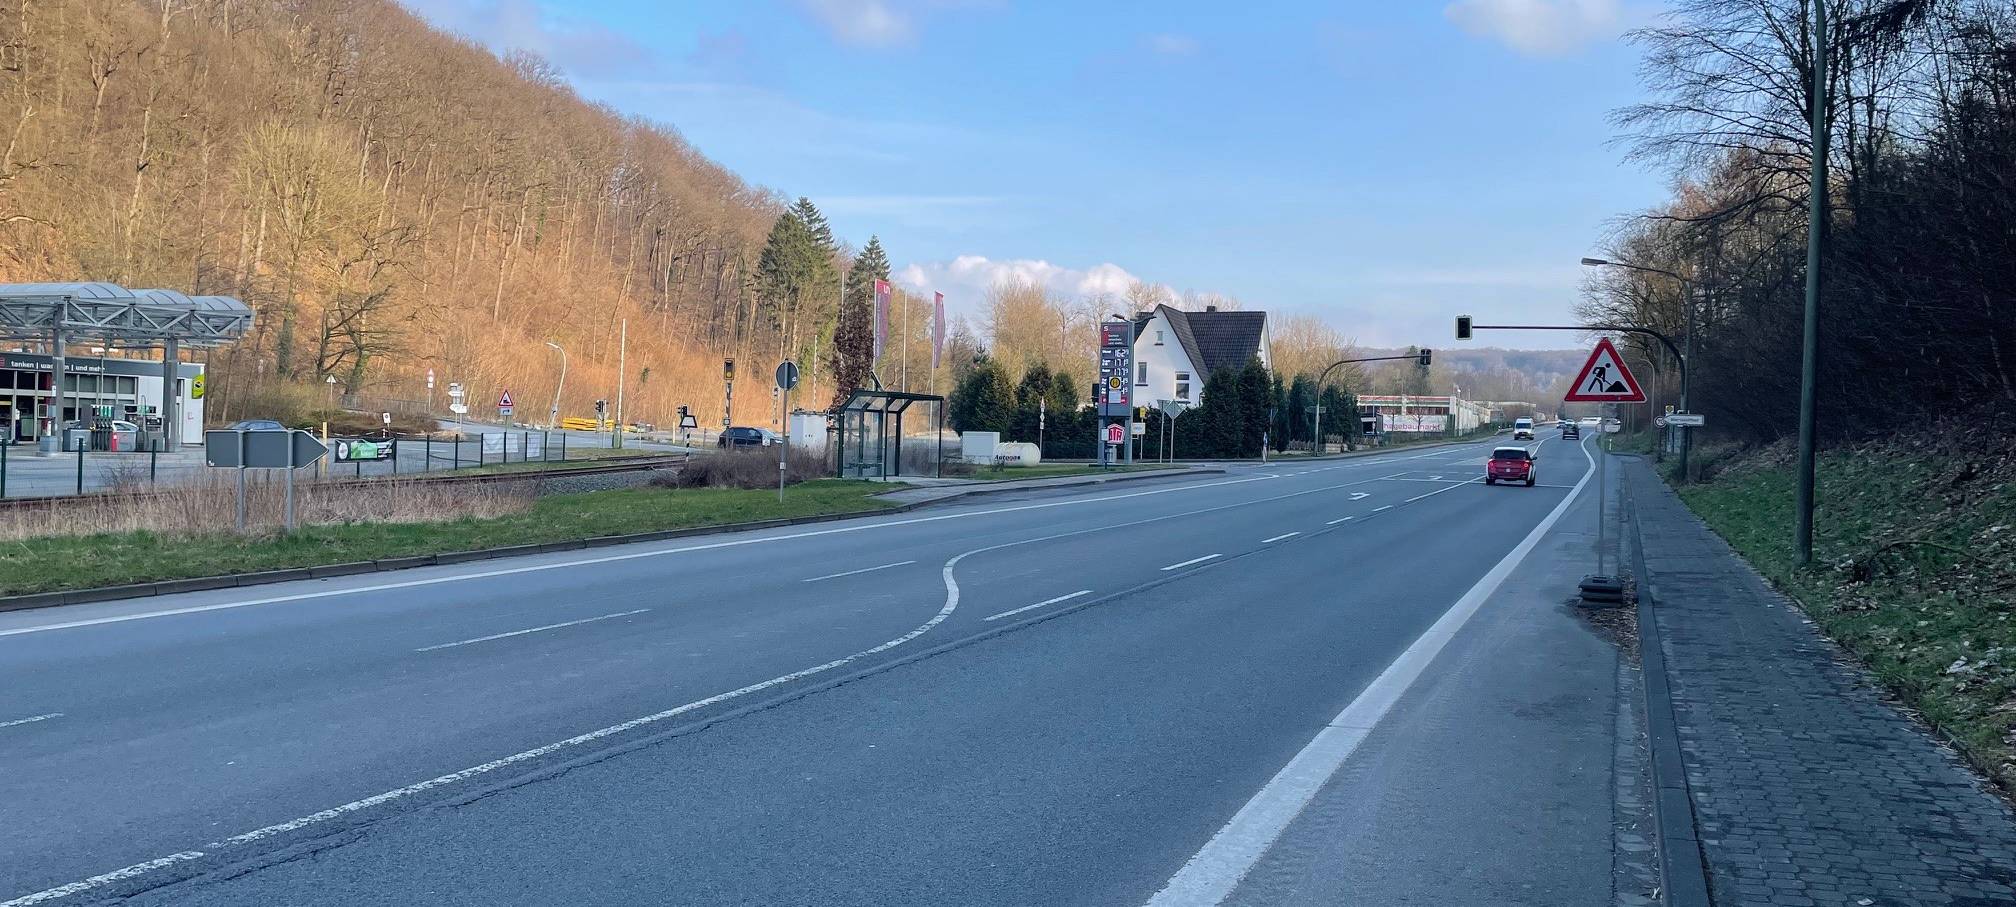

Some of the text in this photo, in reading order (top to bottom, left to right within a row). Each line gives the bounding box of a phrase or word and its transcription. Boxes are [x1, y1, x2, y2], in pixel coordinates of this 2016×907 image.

[11, 360, 34, 368] tanken
[75, 364, 88, 372] und
[1383, 423, 1441, 431] hagebaumarkt
